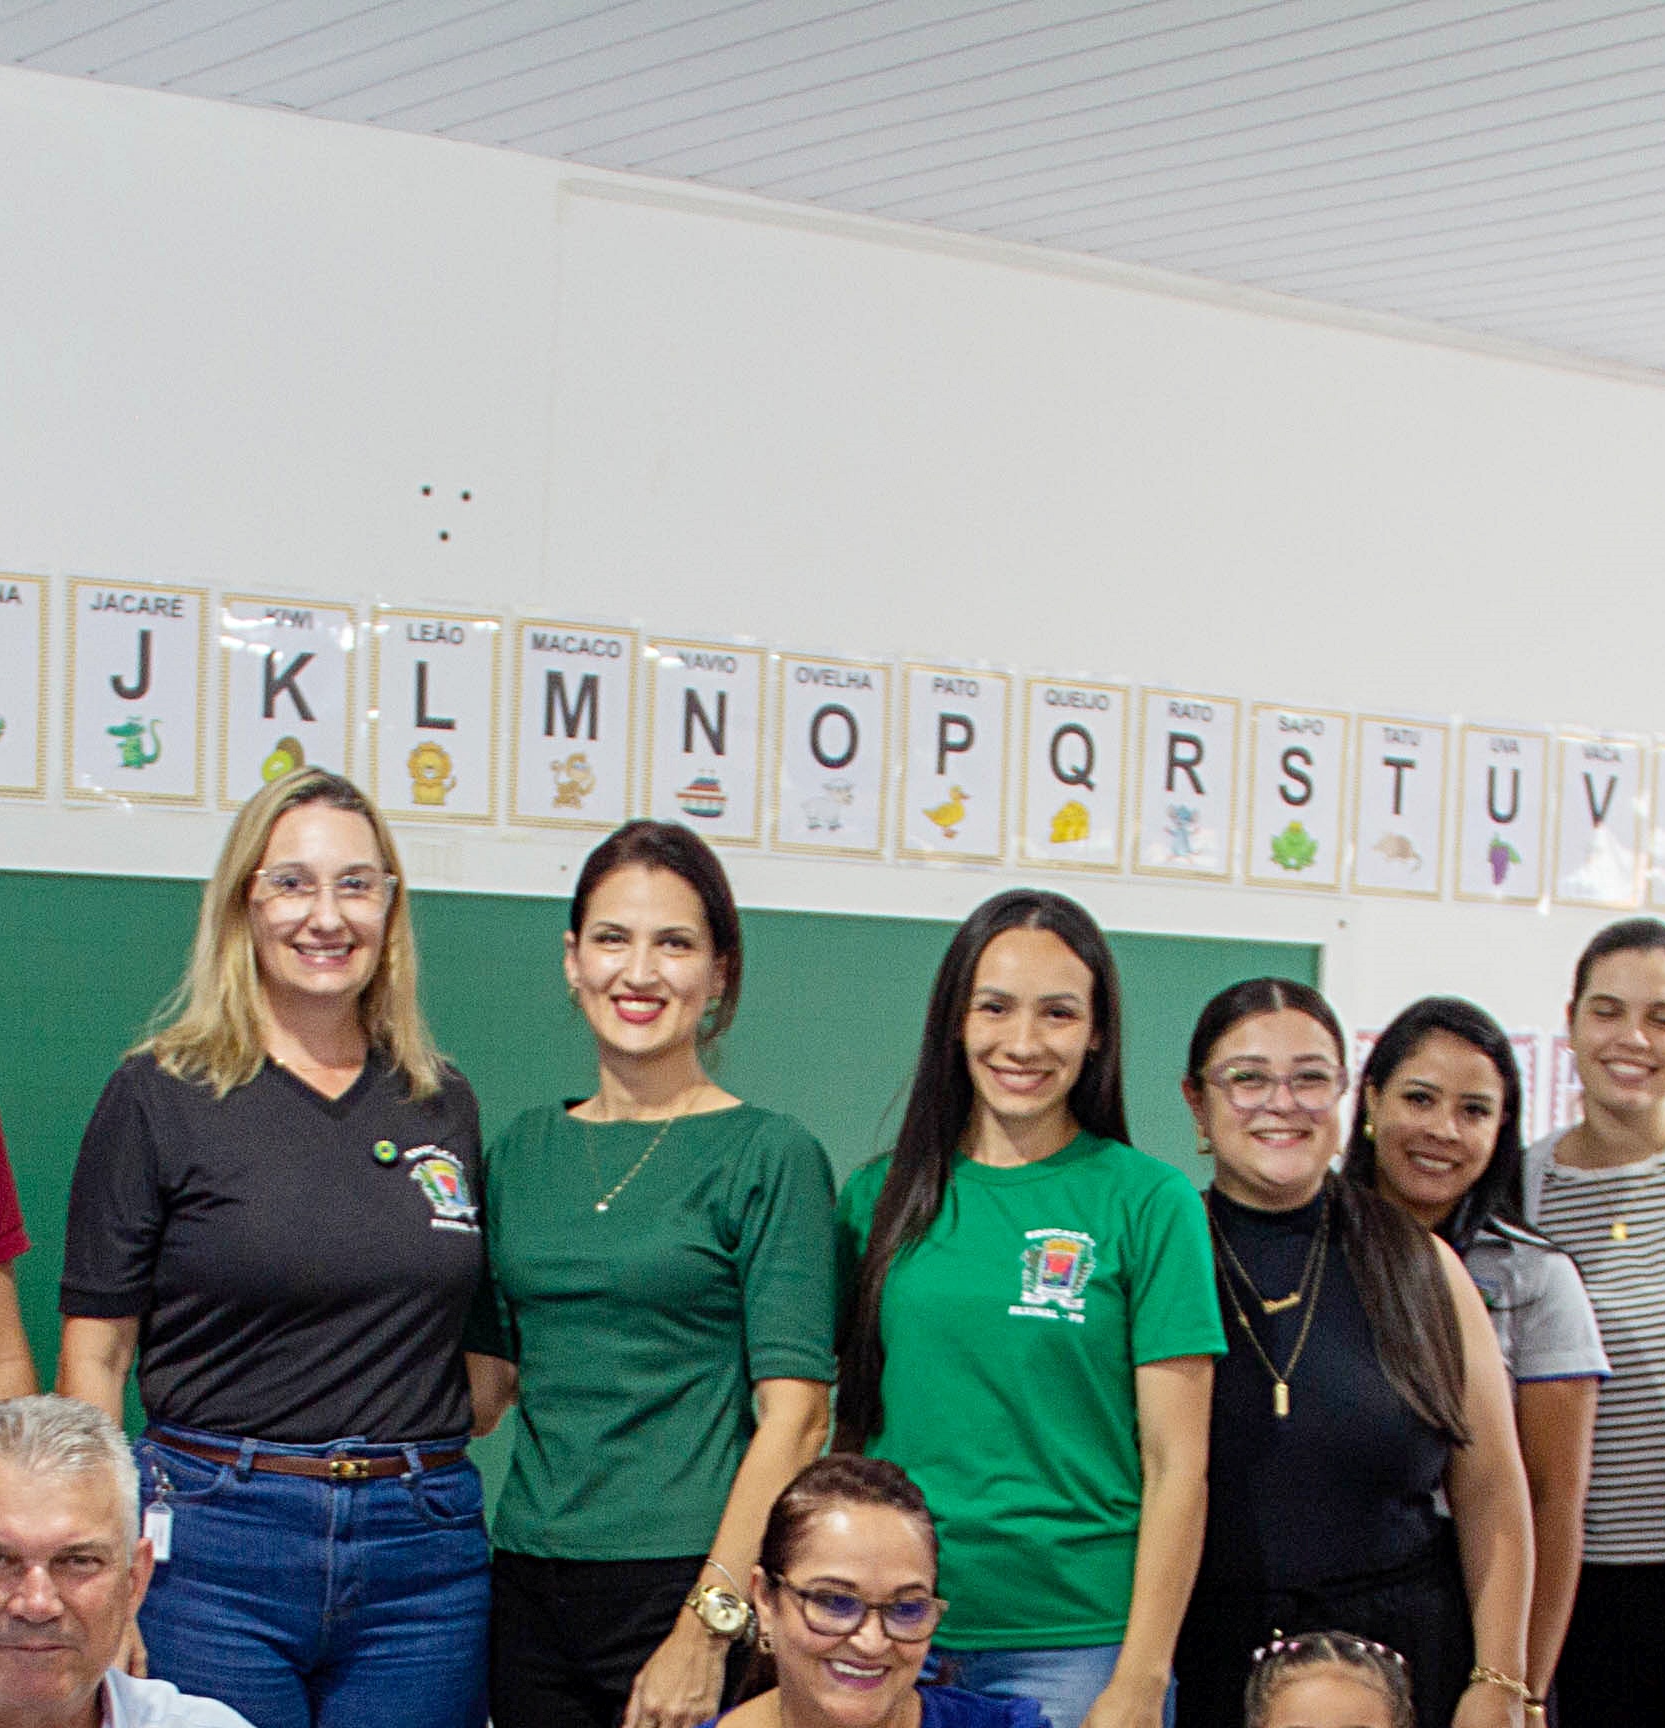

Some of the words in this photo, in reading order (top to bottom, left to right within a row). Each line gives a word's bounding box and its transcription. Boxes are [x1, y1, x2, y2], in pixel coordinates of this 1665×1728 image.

[91, 594, 182, 618] JACARÉ
[408, 623, 464, 645] LEÃO
[111, 630, 151, 700] J
[532, 634, 620, 658] MACACO
[263, 653, 315, 721] K
[416, 662, 455, 730] L
[545, 671, 598, 740] M
[796, 667, 872, 689] OVELHA
[933, 678, 978, 698] PATO
[1045, 689, 1108, 711] QUEIJO
[684, 689, 726, 755] N
[810, 705, 858, 769] O
[1169, 702, 1211, 722] RATO
[1279, 717, 1323, 736] SAPO
[1383, 727, 1418, 746] TATU
[937, 714, 974, 774] P
[1050, 724, 1094, 791] Q
[1166, 733, 1204, 794] R
[1279, 748, 1312, 806] S
[1383, 758, 1415, 815] T
[1487, 767, 1519, 824] U
[1584, 773, 1616, 827] V
